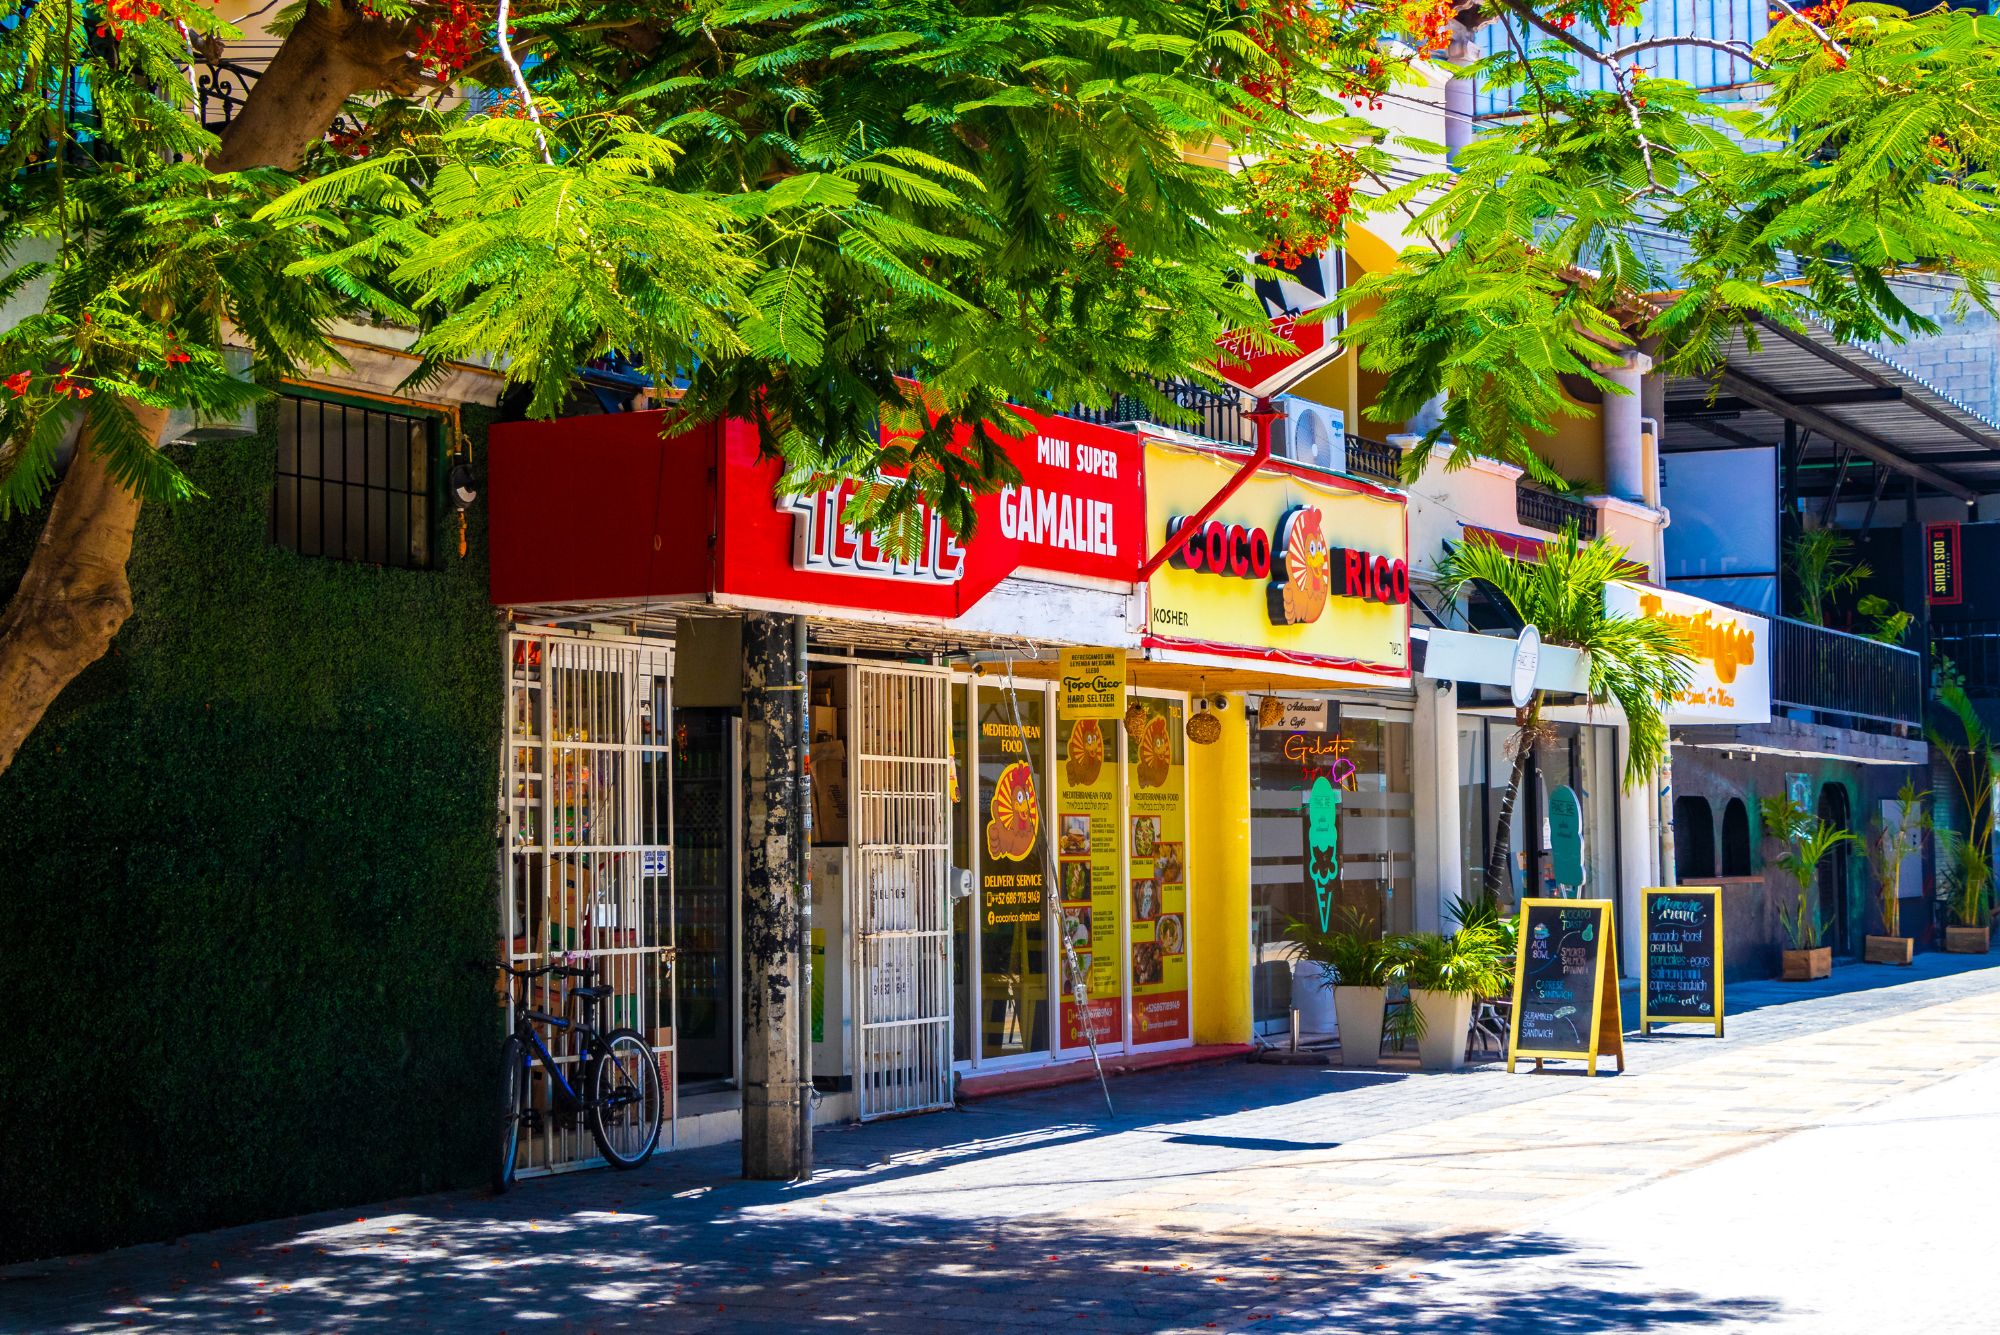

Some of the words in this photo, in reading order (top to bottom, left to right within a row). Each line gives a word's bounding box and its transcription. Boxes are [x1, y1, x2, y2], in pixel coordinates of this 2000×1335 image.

[1038, 436, 1070, 469] MINI
[1076, 444, 1118, 479] SUPER
[1000, 486, 1117, 557] GAMALIEL
[1168, 514, 1271, 579] COCO
[1934, 541, 1945, 560] DOS
[1340, 547, 1409, 604] RICO
[1934, 563, 1946, 592] EQUIS
[1153, 607, 1189, 627] KOSHER
[1063, 676, 1092, 692] Topo
[1092, 676, 1122, 693] Chico
[1068, 694, 1084, 703] HARD
[1087, 694, 1115, 703] SELTZER
[1287, 701, 1322, 712] Artesanal
[982, 723, 1041, 739] MEDITERRANEAN
[1001, 739, 1023, 752] FOOD
[1285, 734, 1357, 764] Gelato
[1063, 791, 1098, 800] MEDITERRANEAN
[1100, 791, 1112, 801] FOOD
[1134, 792, 1166, 801] MEDITERRANEAN
[1168, 793, 1179, 802] FOOD
[985, 875, 1014, 888] DELIVERY
[1016, 874, 1042, 887] SERVICE
[995, 893, 1005, 906] +52
[1006, 893, 1017, 905] 686
[1018, 892, 1027, 904] 718
[1028, 891, 1040, 904] 9149
[996, 912, 1018, 923] cocorico
[1019, 911, 1040, 922] shnitzel
[1560, 909, 1591, 920] AVOCADO
[1562, 920, 1583, 931] TOAST
[1682, 930, 1702, 942] toast
[1561, 947, 1586, 957] SMOKED
[1667, 942, 1683, 953] bowl
[1532, 950, 1550, 960] BOWL
[1562, 956, 1586, 966] SALMON
[1690, 956, 1710, 968] eggs
[1539, 989, 1573, 1000] SANDWICH
[1524, 1010, 1554, 1021] SCRAMBLED
[1522, 1019, 1535, 1028] EGG
[1522, 1028, 1554, 1039] SANDWICH
